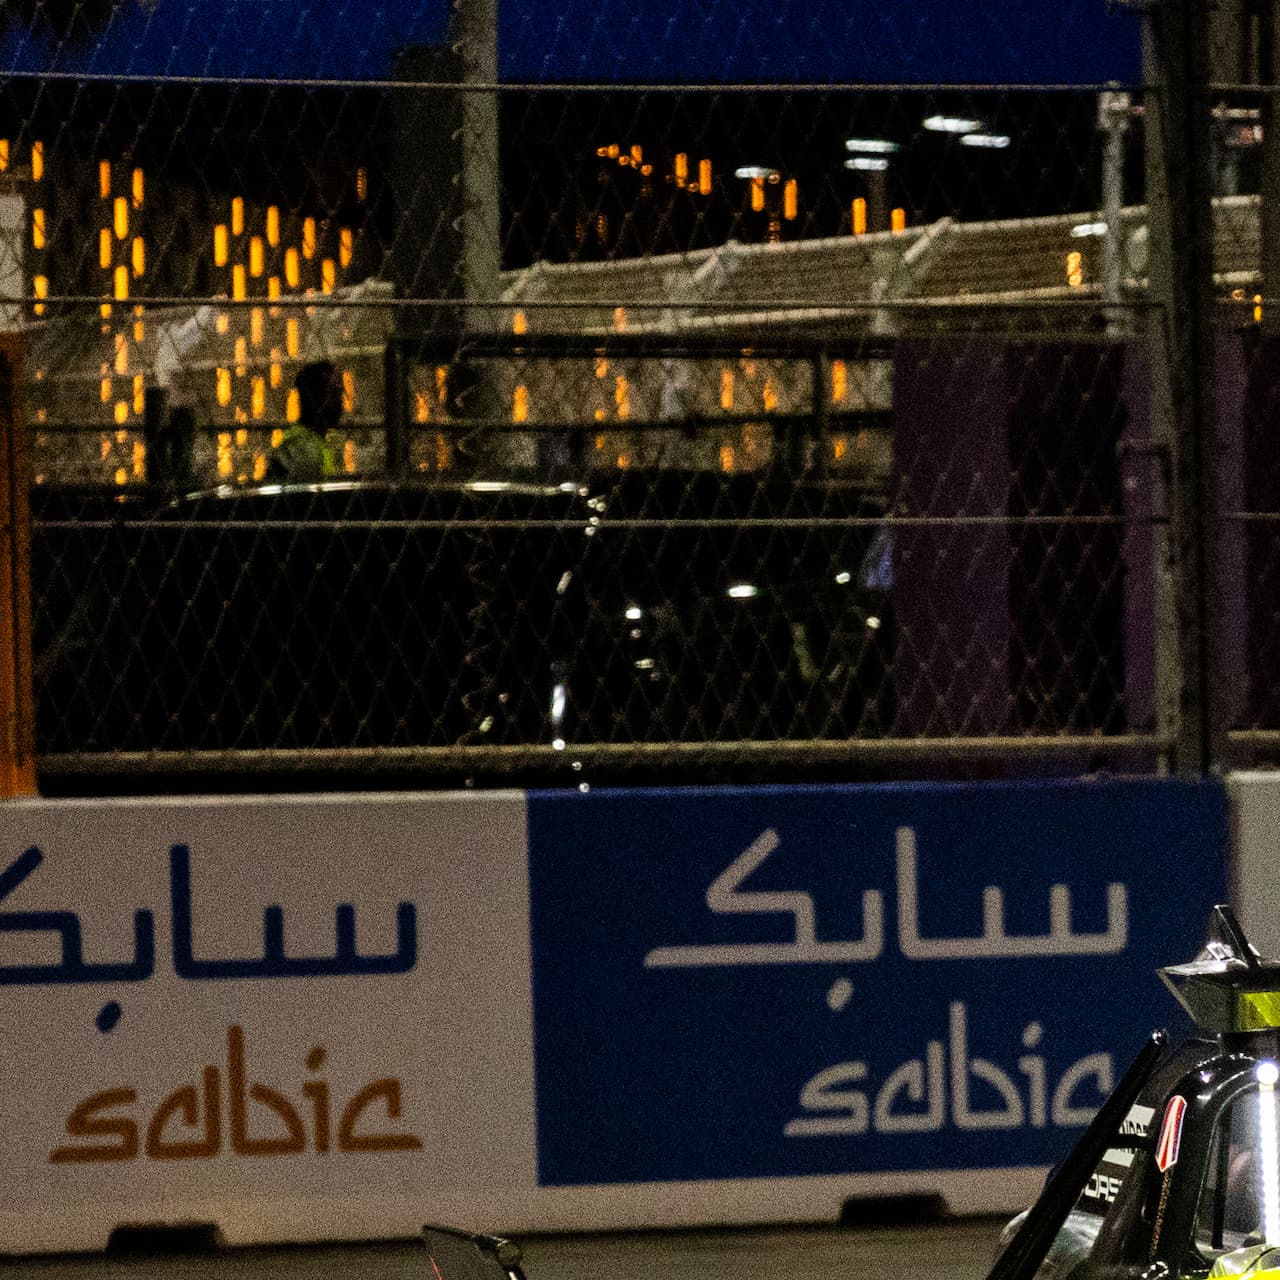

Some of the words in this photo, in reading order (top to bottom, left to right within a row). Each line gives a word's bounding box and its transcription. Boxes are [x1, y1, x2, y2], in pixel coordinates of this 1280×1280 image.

[644, 827, 1129, 1012] سابك
[50, 1025, 423, 1165] sabic
[783, 999, 1116, 1137] sabic
